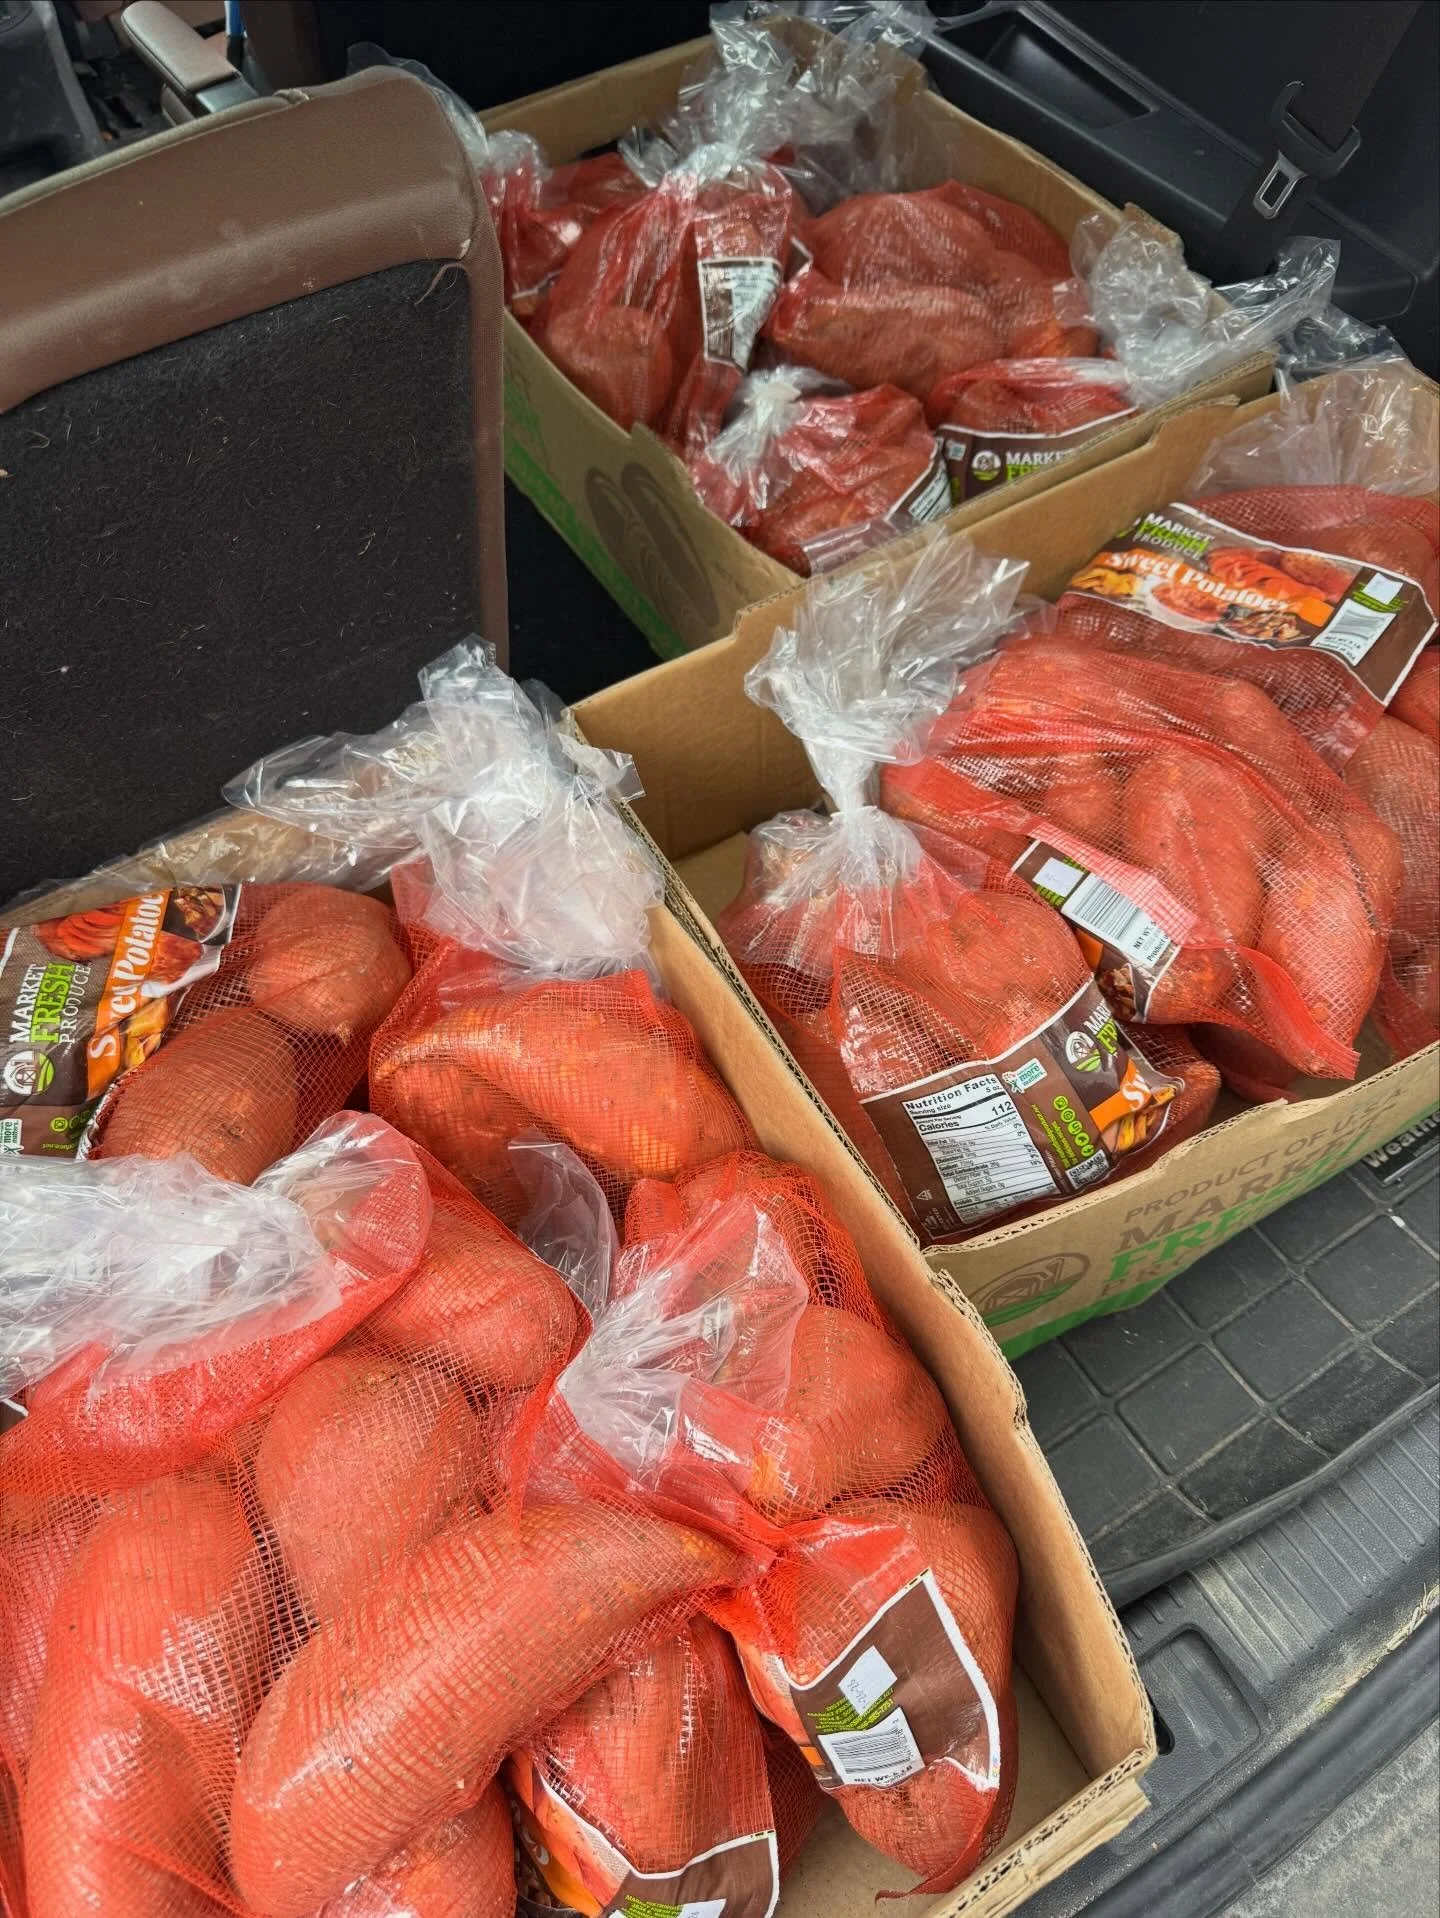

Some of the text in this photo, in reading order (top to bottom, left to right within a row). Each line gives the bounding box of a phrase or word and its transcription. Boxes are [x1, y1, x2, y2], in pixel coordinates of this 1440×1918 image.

[1143, 512, 1216, 541] MARKET
[1180, 567, 1290, 611] Potatoes
[1133, 936, 1144, 950] NET
[1147, 938, 1166, 962] Product
[9, 963, 47, 1043] MARKET
[30, 962, 75, 1043] FRESH
[59, 964, 92, 1045] PRODUCE
[1018, 1064, 1041, 1082] more
[905, 1076, 998, 1110] Nutrition Facts
[909, 1108, 936, 1116] Serving
[936, 1103, 952, 1112] size
[919, 1100, 1014, 1132] Calories 112
[3, 1121, 12, 1144] more
[954, 1164, 988, 1174] Carbohydrate
[1125, 1150, 1277, 1223] PRODUCT
[1282, 1128, 1329, 1157] OF
